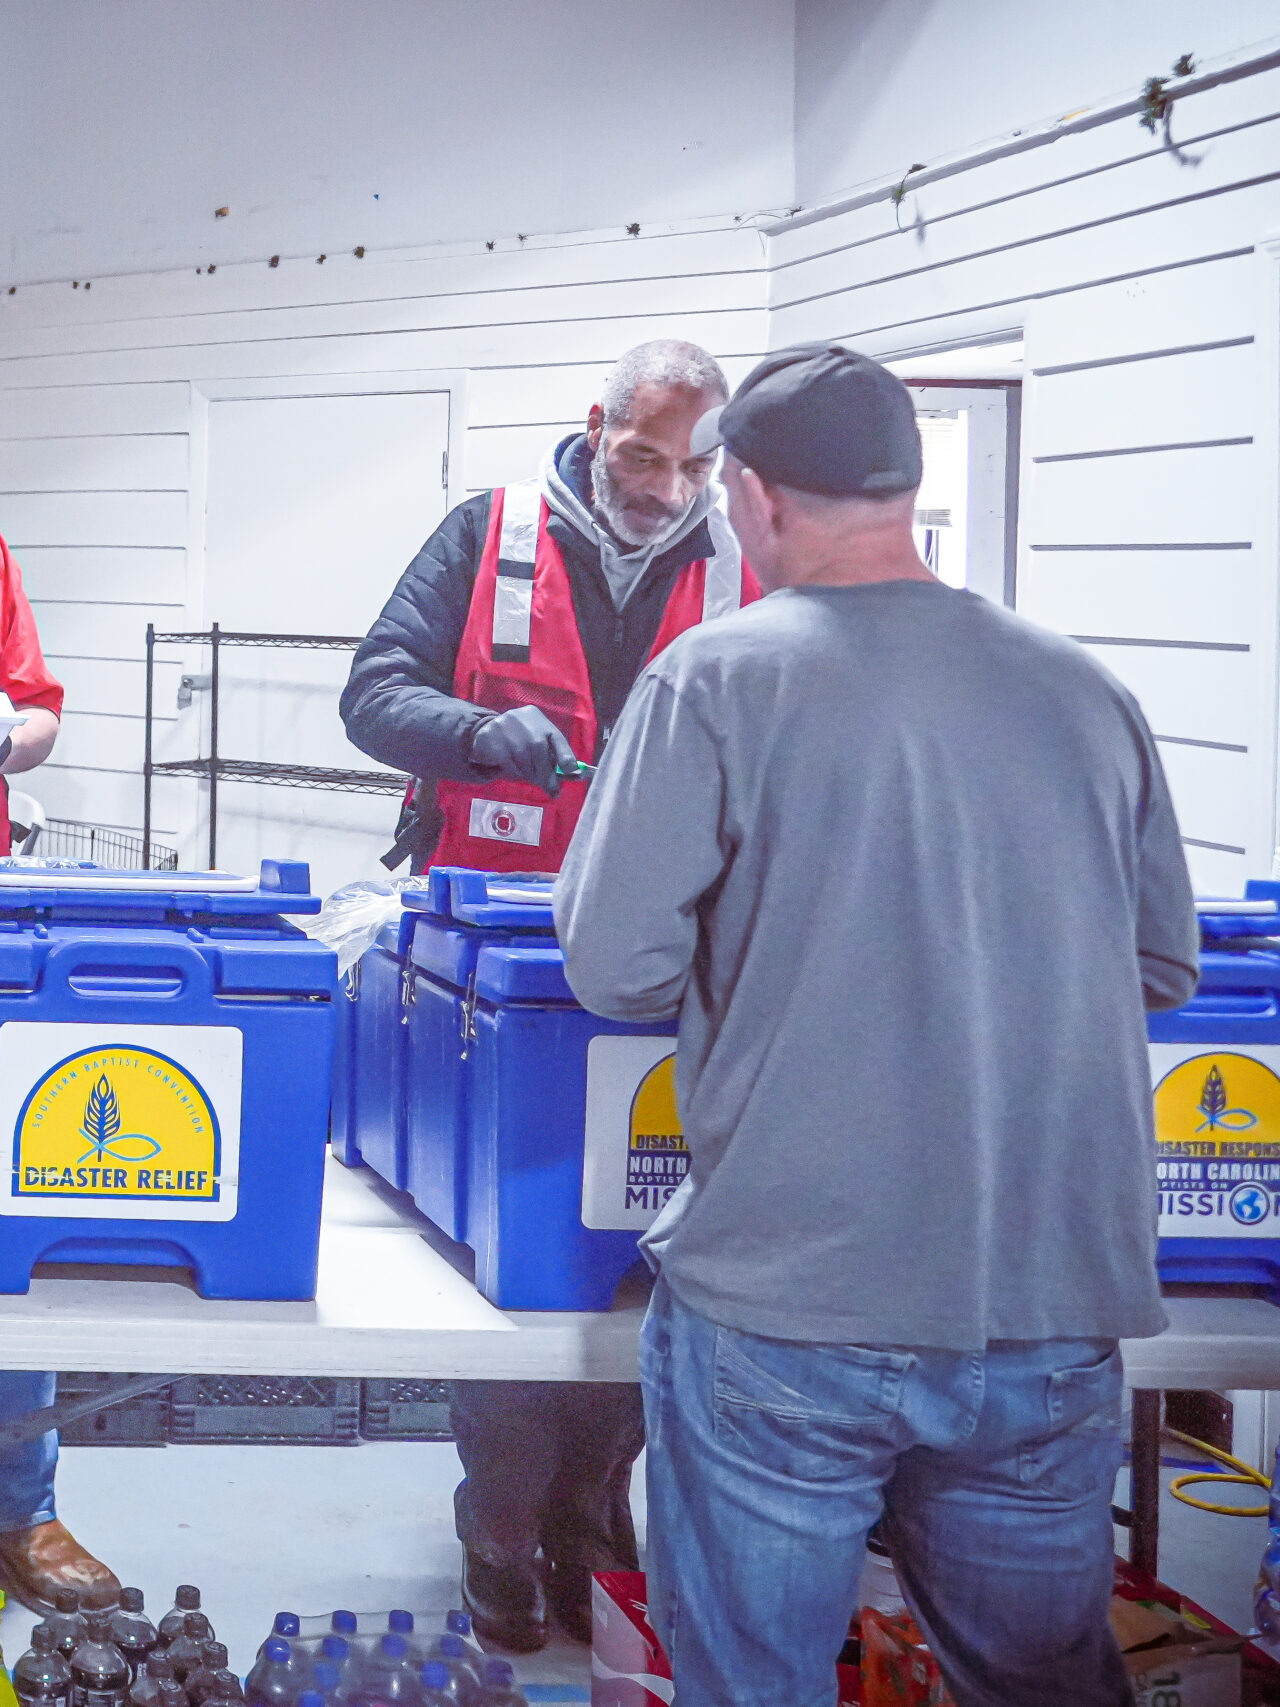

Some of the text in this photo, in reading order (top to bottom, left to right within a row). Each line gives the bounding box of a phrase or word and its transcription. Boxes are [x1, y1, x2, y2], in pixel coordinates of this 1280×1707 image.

[32, 1056, 204, 1133] SOUTHERN BAPTIST CONVENTION
[636, 1134, 688, 1149] DISAST
[629, 1156, 688, 1174] NORTH
[24, 1166, 208, 1190] DISASTER RELIEF
